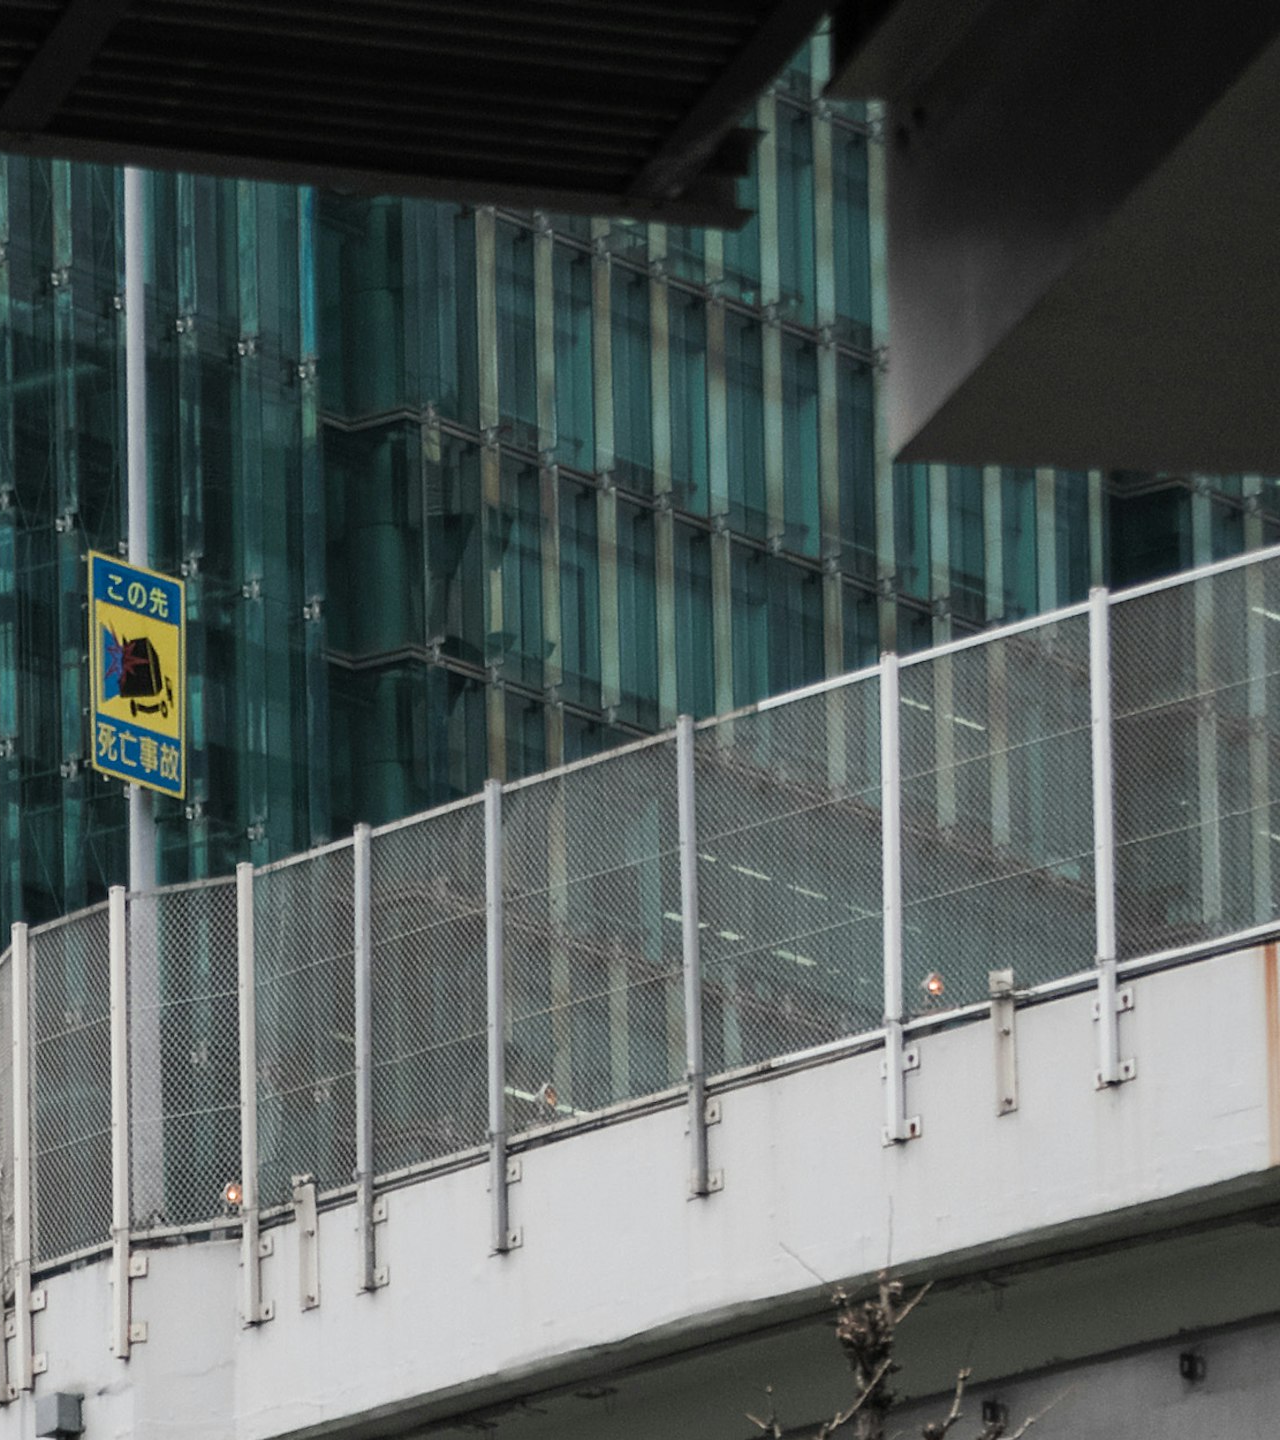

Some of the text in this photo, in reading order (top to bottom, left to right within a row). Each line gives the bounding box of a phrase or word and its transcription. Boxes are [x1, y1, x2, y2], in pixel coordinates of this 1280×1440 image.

[107, 573, 169, 619] この先
[97, 722, 180, 782] 死亡事故
